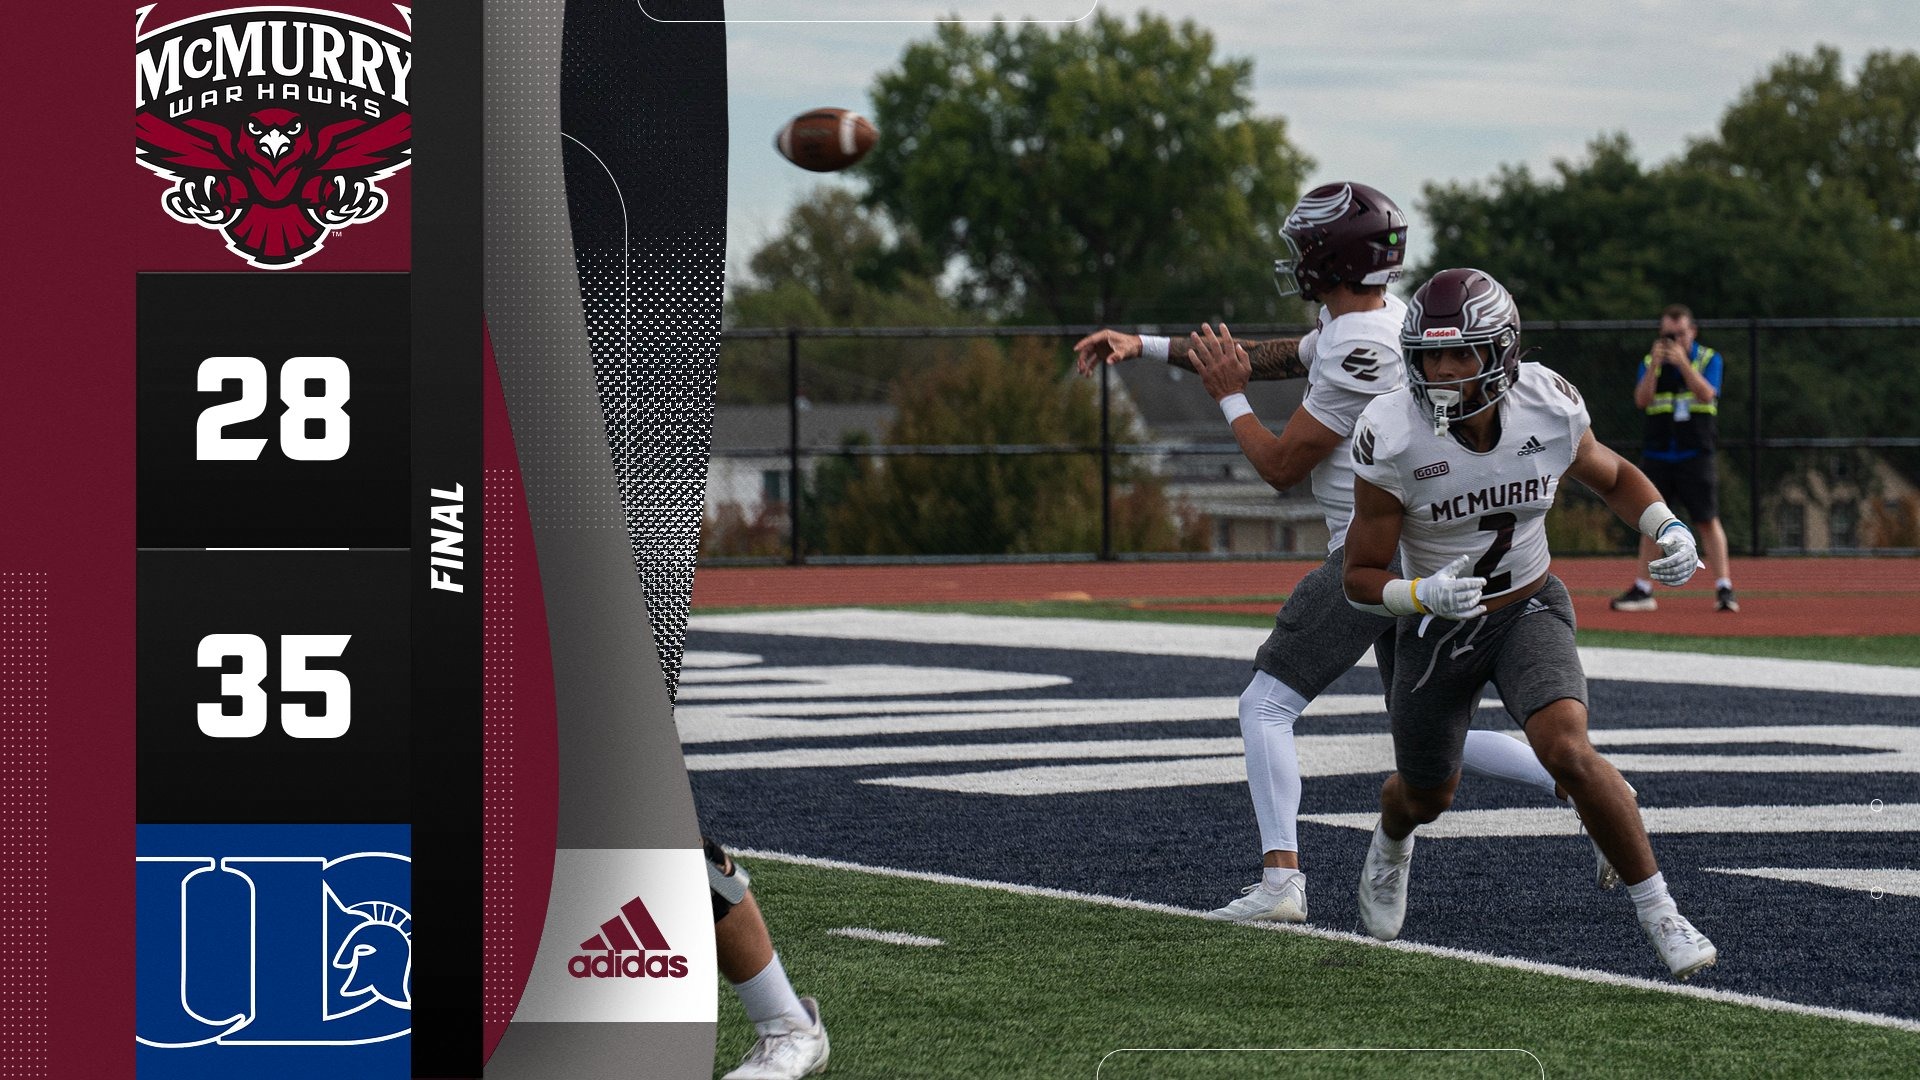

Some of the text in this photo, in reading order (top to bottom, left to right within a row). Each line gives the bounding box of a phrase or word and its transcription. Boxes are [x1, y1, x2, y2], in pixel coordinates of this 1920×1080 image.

[1517, 446, 1546, 456] adidas
[1417, 464, 1446, 477] GOOD
[1431, 475, 1551, 522] MCMURRY
[1473, 512, 1518, 597] 2
